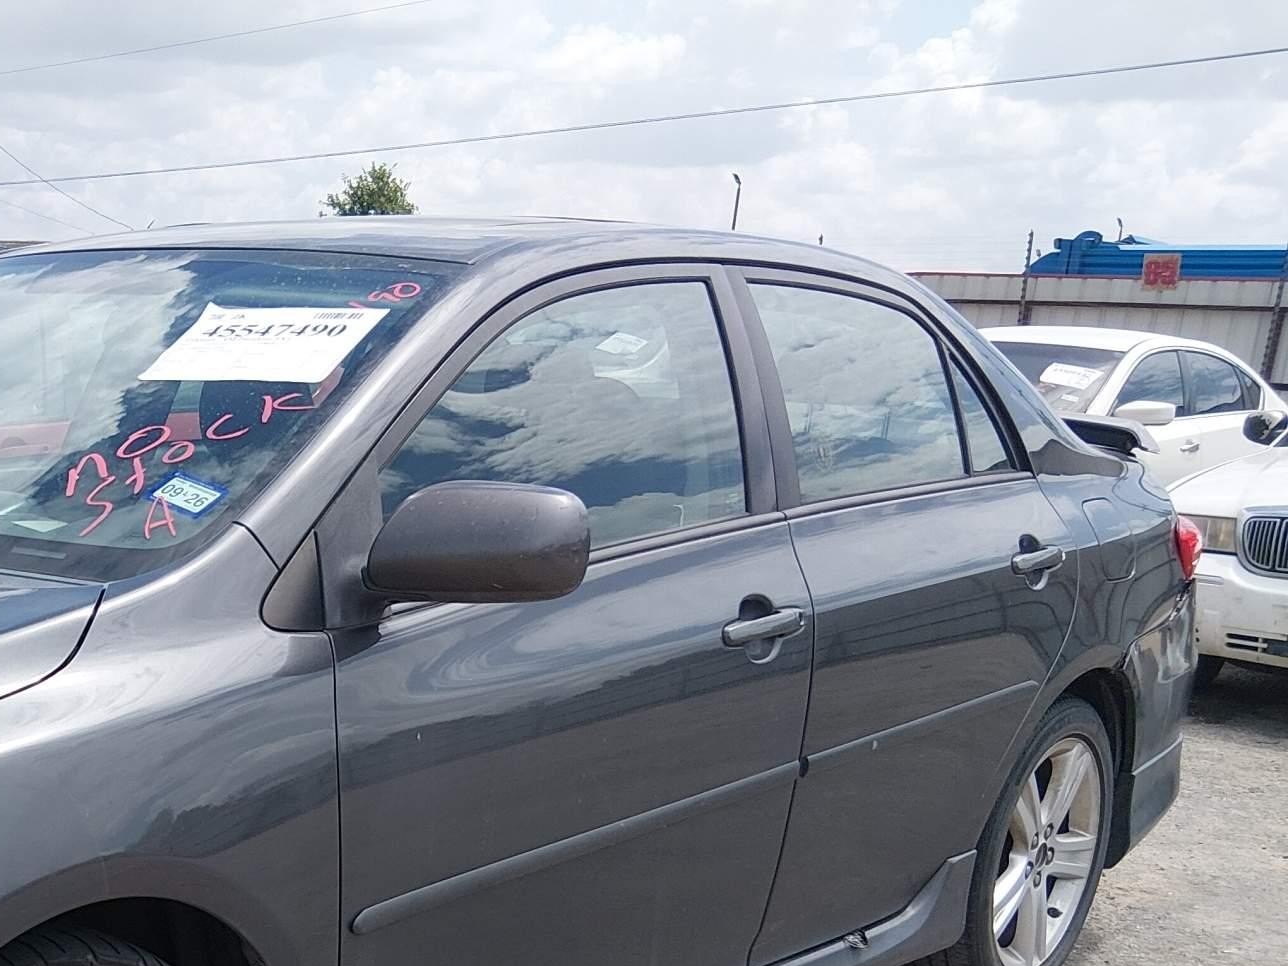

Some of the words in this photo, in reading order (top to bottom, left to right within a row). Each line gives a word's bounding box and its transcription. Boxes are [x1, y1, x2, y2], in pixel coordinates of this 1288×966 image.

[202, 324, 348, 337] 45547490
[160, 484, 185, 498] 09
[184, 492, 209, 508] 26
